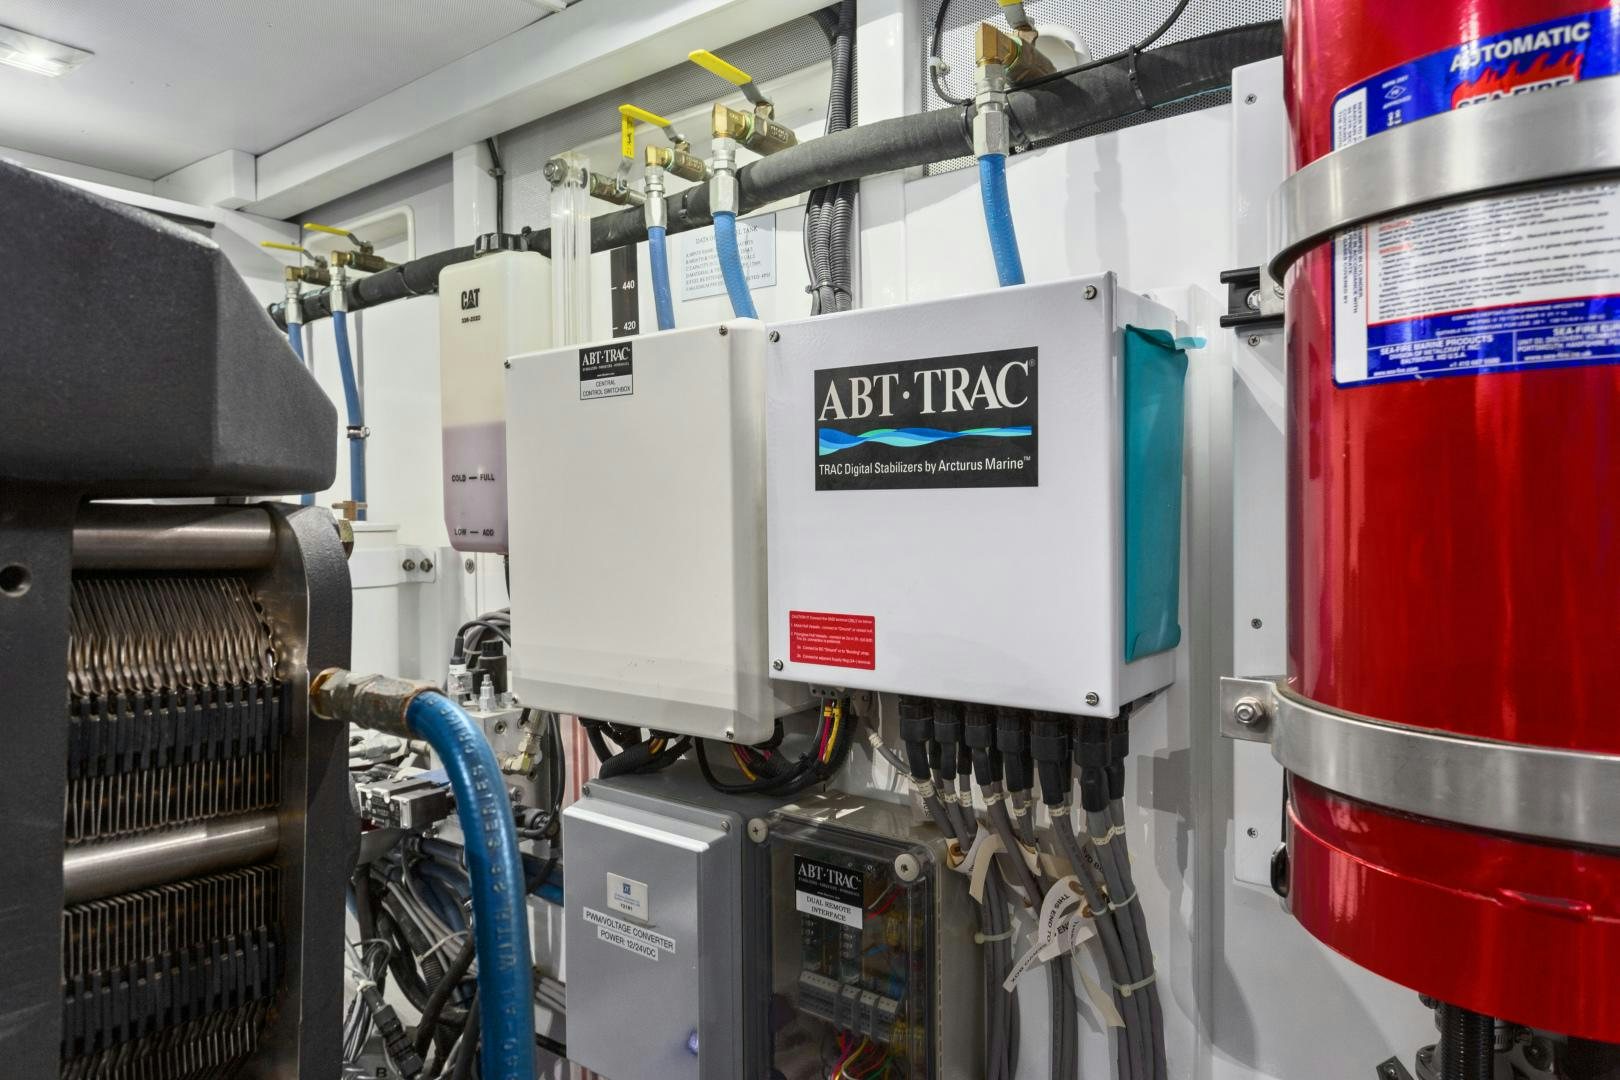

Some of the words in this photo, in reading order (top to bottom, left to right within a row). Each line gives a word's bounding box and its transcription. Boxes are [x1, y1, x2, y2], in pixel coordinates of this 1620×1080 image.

[1450, 21, 1591, 73] AUTOMATIC
[622, 280, 635, 290] 440
[461, 288, 480, 310] CAT
[623, 320, 636, 331] 420
[583, 389, 604, 397] CONTROL
[604, 386, 631, 395] SWITCHBOX
[819, 463, 843, 476] TRAC
[844, 461, 873, 477] Digital
[874, 460, 923, 474] Stabilizers
[924, 460, 936, 475] by
[938, 459, 983, 472] Arcturus
[451, 474, 467, 482] COLD
[479, 473, 495, 481] FULL
[454, 528, 467, 536] LOW
[482, 528, 495, 537] ADD
[472, 764, 501, 849] SERIES
[806, 895, 823, 906] DUAL
[825, 901, 851, 914] REMOTE
[1054, 893, 1071, 909] THIS
[811, 906, 846, 921] INTERFACE
[1047, 909, 1057, 928] END
[632, 927, 674, 950] CONVERTER
[626, 939, 656, 958] 12/24VDC
